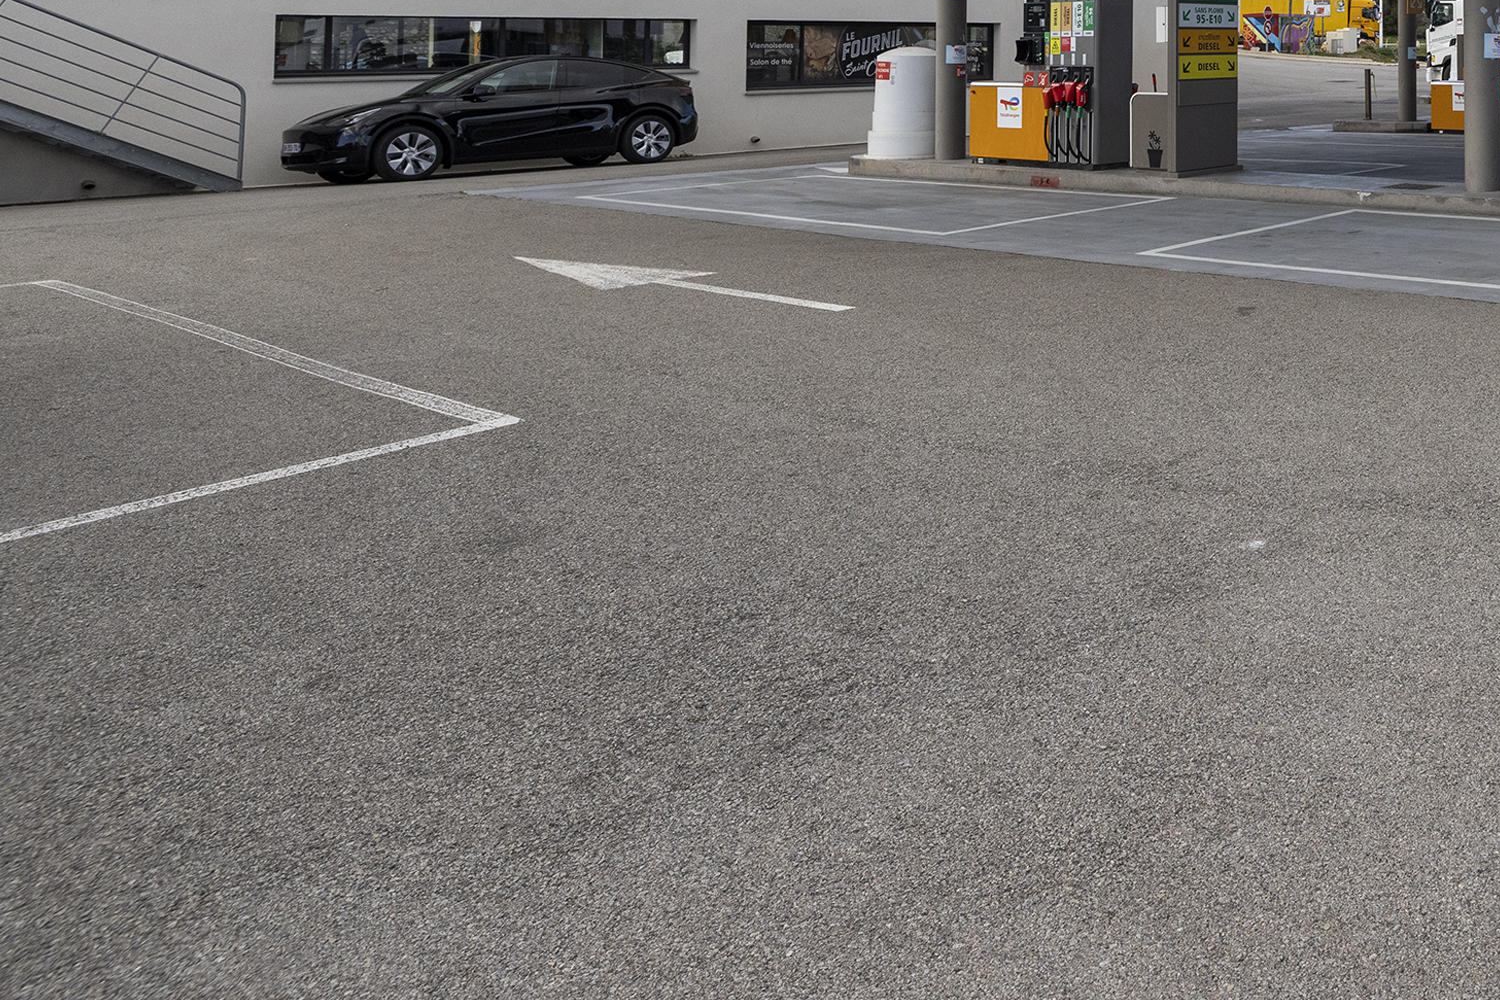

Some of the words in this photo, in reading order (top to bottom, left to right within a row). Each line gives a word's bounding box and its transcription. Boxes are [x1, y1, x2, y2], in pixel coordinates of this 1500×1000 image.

[1196, 14, 1223, 24] 95-E10
[845, 31, 856, 41] LE
[842, 28, 903, 62] FOURNIL
[1198, 42, 1220, 51] DIESEL
[749, 58, 769, 66] Salon
[781, 57, 792, 65] thé
[1198, 62, 1220, 71] DIESEL
[844, 59, 868, 77] Saint
